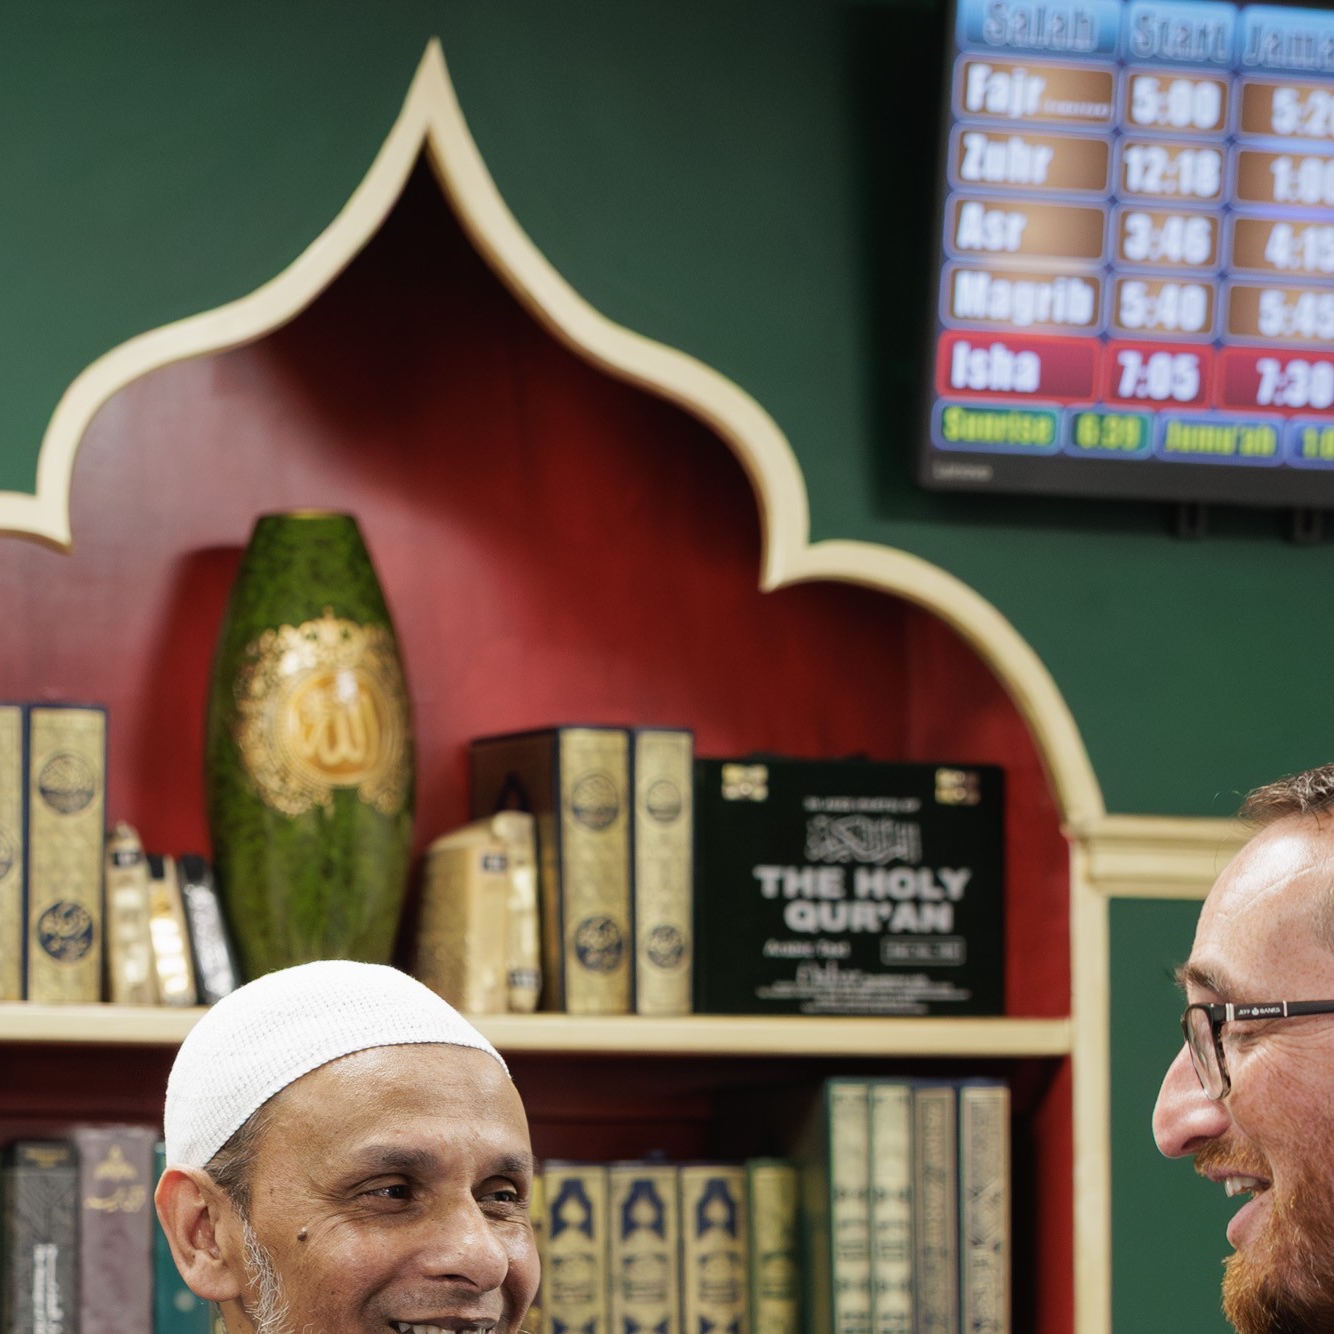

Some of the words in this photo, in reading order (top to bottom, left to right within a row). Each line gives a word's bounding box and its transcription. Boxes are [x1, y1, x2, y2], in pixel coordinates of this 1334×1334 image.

[982, 1, 1098, 52] Salah
[1131, 10, 1227, 62] Start
[967, 63, 1046, 118] Fajr
[1132, 75, 1222, 129] 5:00
[960, 132, 1054, 184] Zuhr
[1123, 145, 1221, 198] 12:18
[956, 203, 1027, 252] Asr
[954, 270, 1094, 326] Magrib
[1119, 280, 1208, 332] 5:40
[950, 340, 1041, 393] Isha
[1116, 349, 1200, 400] 7:05
[941, 405, 1053, 445] Sunrise
[752, 865, 846, 899] THE
[854, 866, 972, 901] HOLY
[783, 899, 955, 934] QUR'AN
